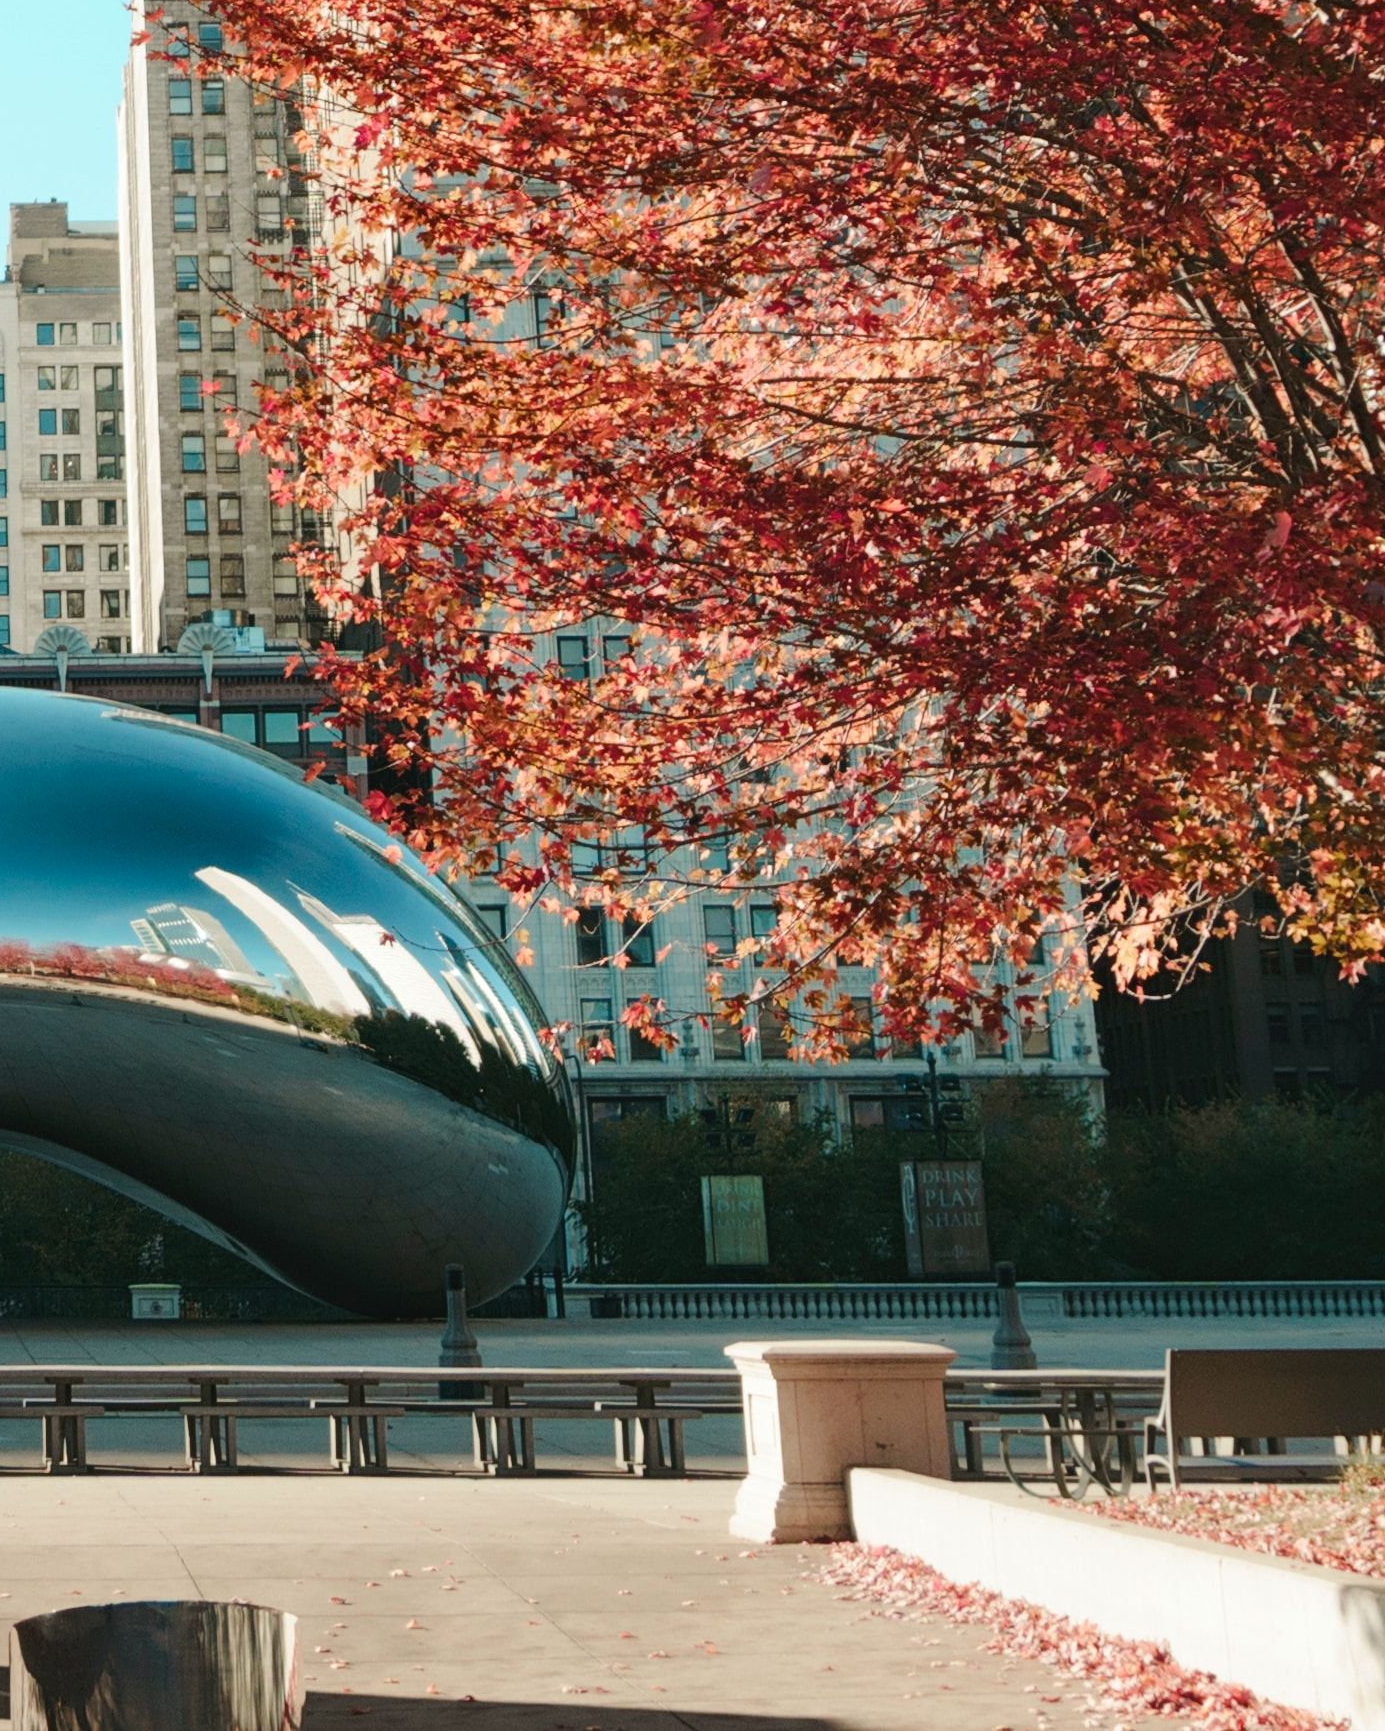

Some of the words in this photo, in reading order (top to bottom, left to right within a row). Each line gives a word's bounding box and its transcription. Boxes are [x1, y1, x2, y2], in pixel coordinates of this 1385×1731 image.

[922, 1169, 980, 1183] DRINK
[925, 1188, 981, 1207] PLAY
[926, 1212, 985, 1227] SHARE
